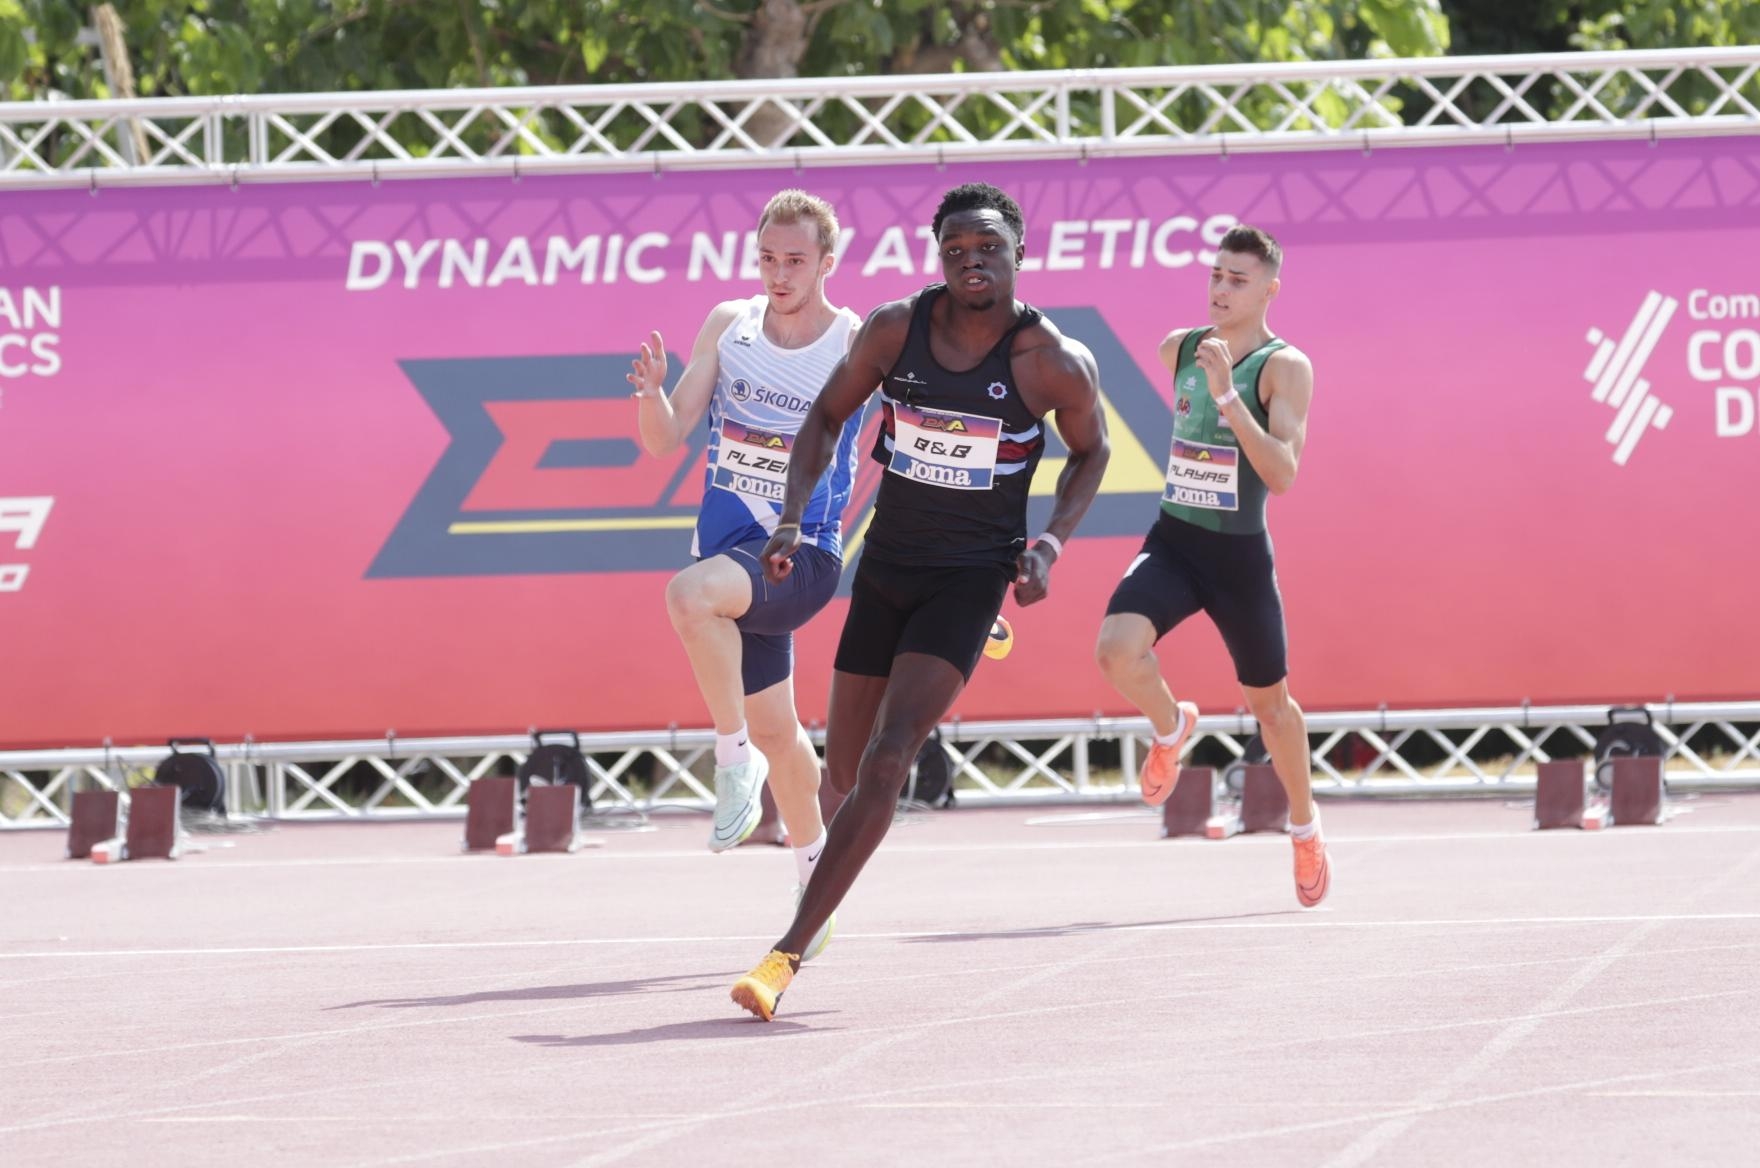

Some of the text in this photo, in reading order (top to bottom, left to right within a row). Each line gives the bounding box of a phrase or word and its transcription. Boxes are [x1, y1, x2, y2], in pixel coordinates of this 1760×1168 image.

[345, 214, 1239, 291] DYNAMIC NE ATETICS
[753, 385, 813, 413] ŠKODA
[1715, 386, 1760, 438] D
[905, 459, 972, 487] Joma
